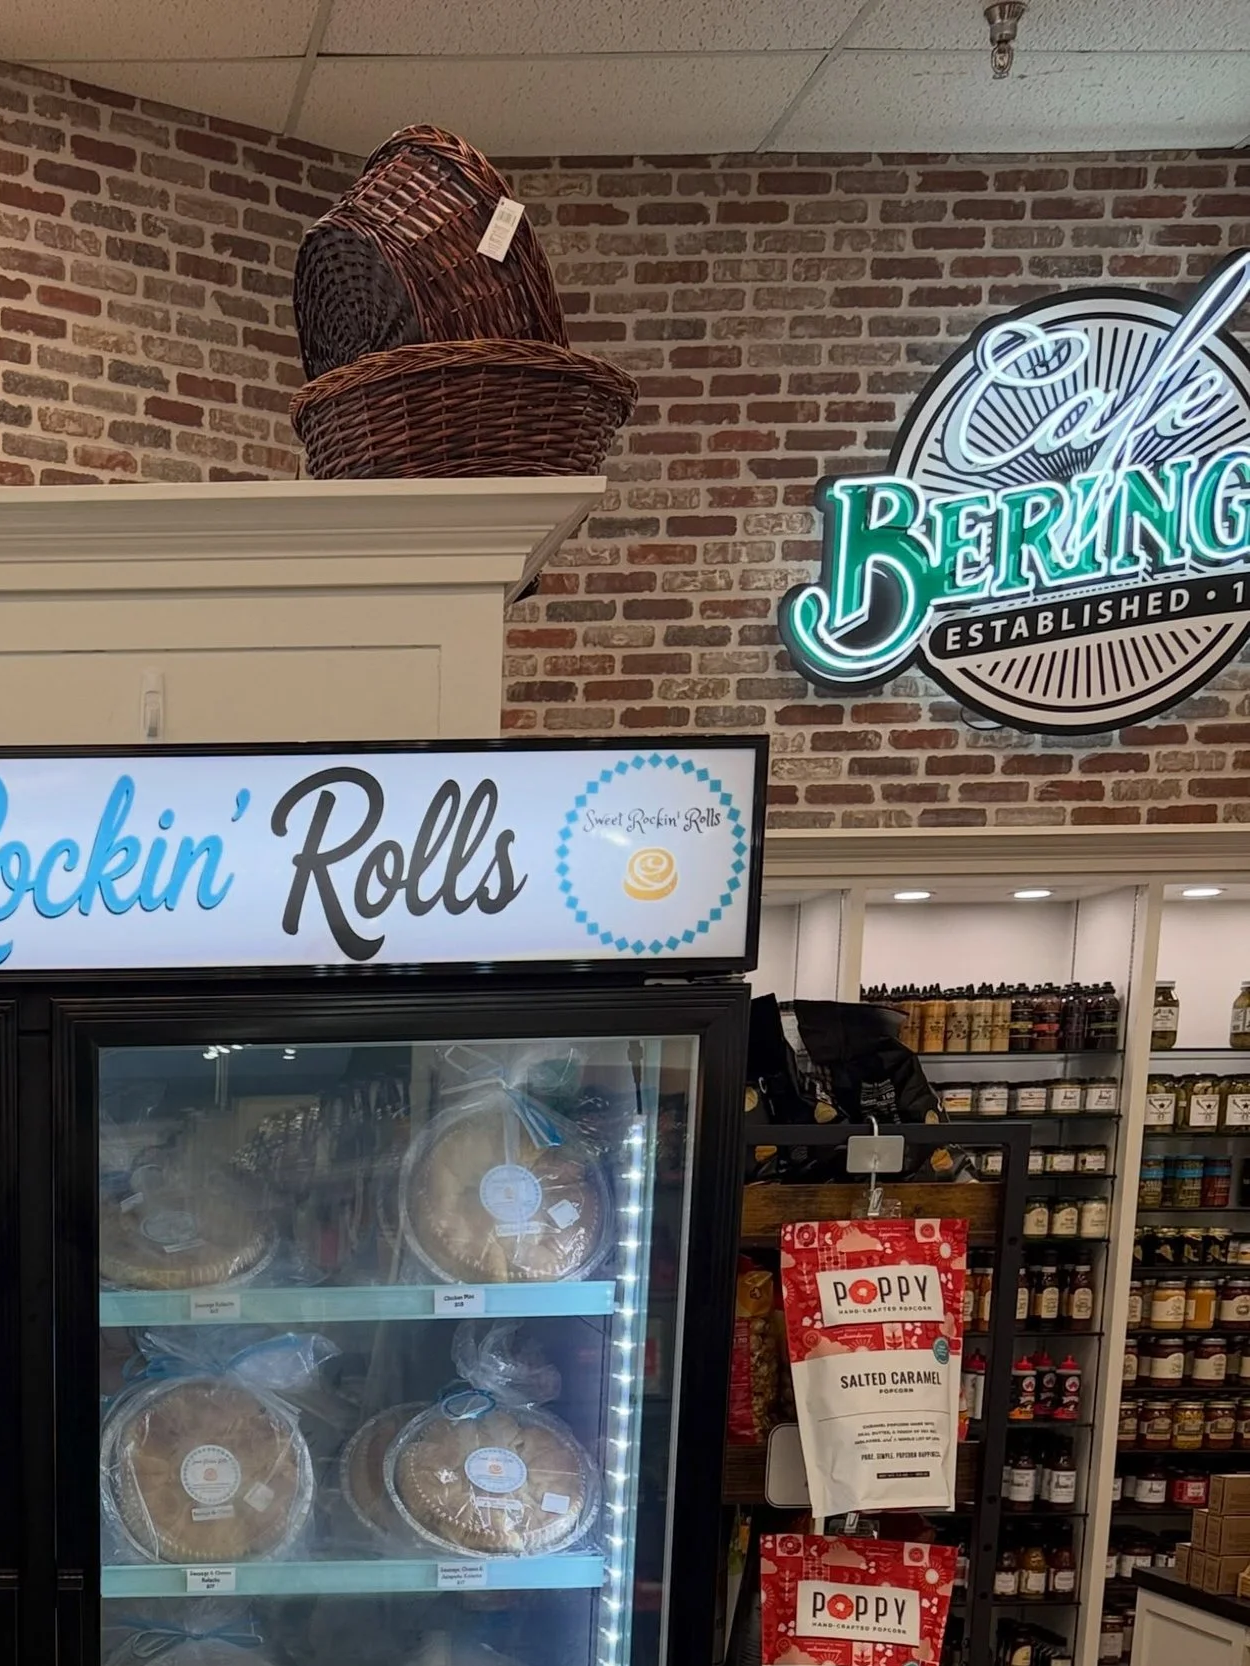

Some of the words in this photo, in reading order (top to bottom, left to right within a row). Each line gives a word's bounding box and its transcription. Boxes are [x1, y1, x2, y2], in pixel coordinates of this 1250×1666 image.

[944, 590, 1191, 651] ESTABLISHED
[583, 809, 623, 832] Sweet
[626, 808, 680, 834] Rockin'
[683, 807, 721, 834] Rolls
[270, 765, 527, 961] Rolls
[841, 1372, 887, 1389] SALTED
[891, 1370, 942, 1386] CARAMEL
